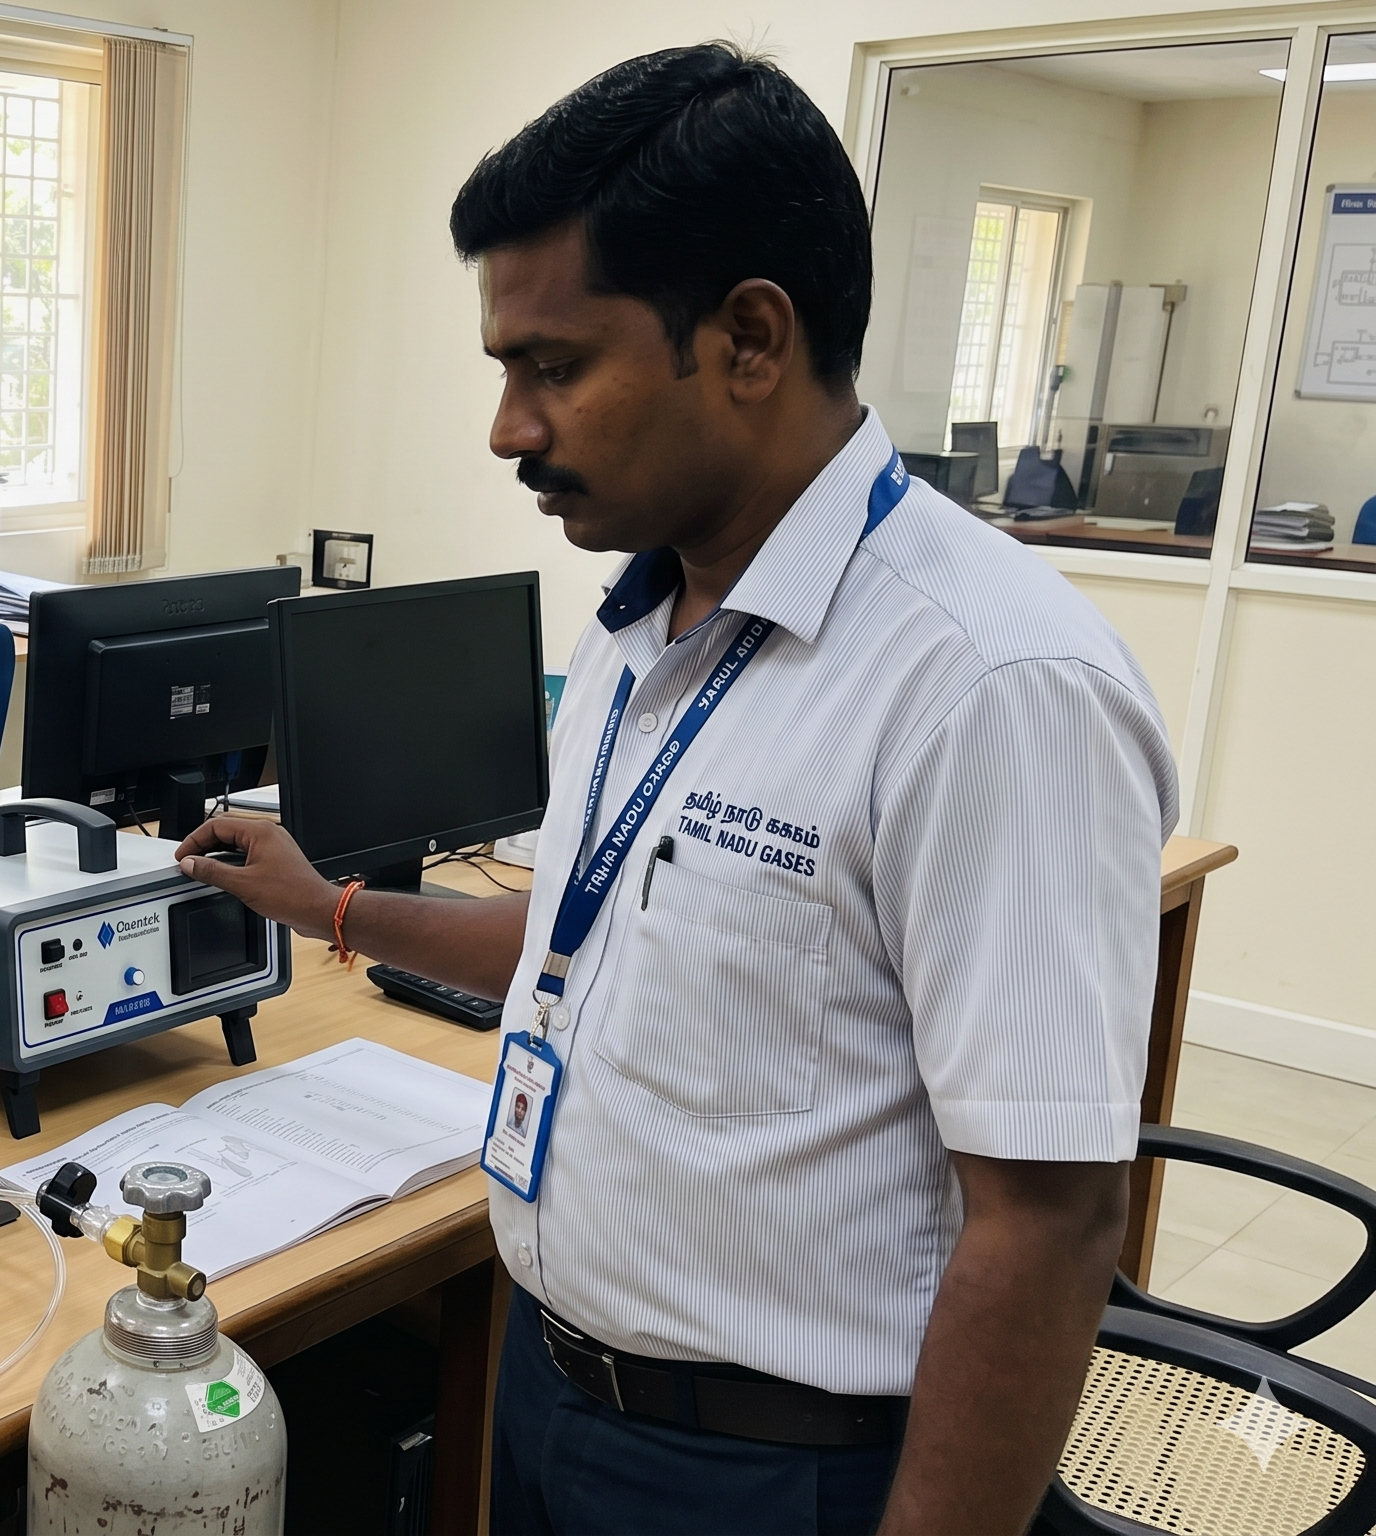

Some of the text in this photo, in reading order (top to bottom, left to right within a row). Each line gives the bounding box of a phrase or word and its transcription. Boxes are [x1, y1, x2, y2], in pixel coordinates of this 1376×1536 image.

[611, 797, 645, 847] NADU
[678, 815, 816, 877] TAMIL NADU GASES
